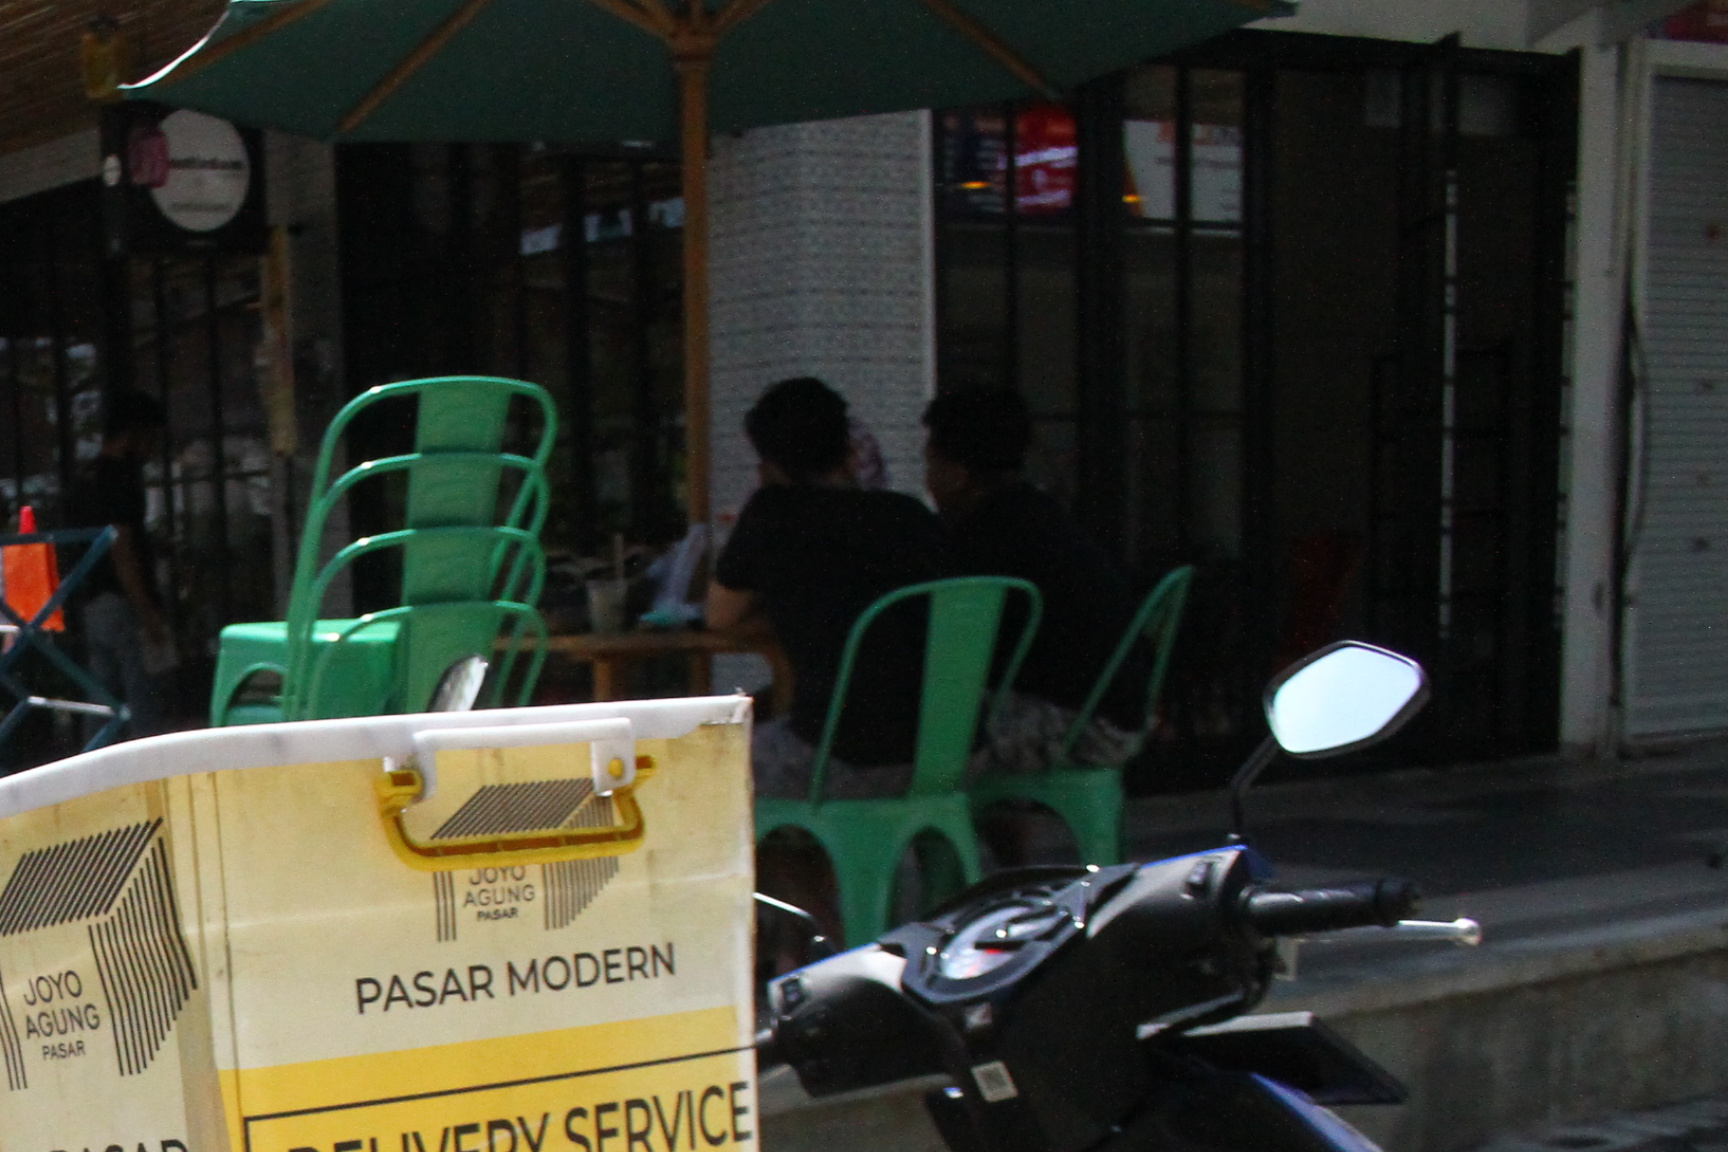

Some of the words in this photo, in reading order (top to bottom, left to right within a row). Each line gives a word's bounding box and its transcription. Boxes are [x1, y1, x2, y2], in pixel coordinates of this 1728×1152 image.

[469, 866, 527, 886] JOYO
[462, 884, 536, 908] AGUNG
[476, 905, 520, 922] PASAR
[22, 968, 84, 1006] JOYO
[355, 964, 495, 1015] PASAR
[506, 942, 675, 997] MODERN
[25, 1004, 101, 1038] AGUNG
[42, 1040, 87, 1061] PASAR
